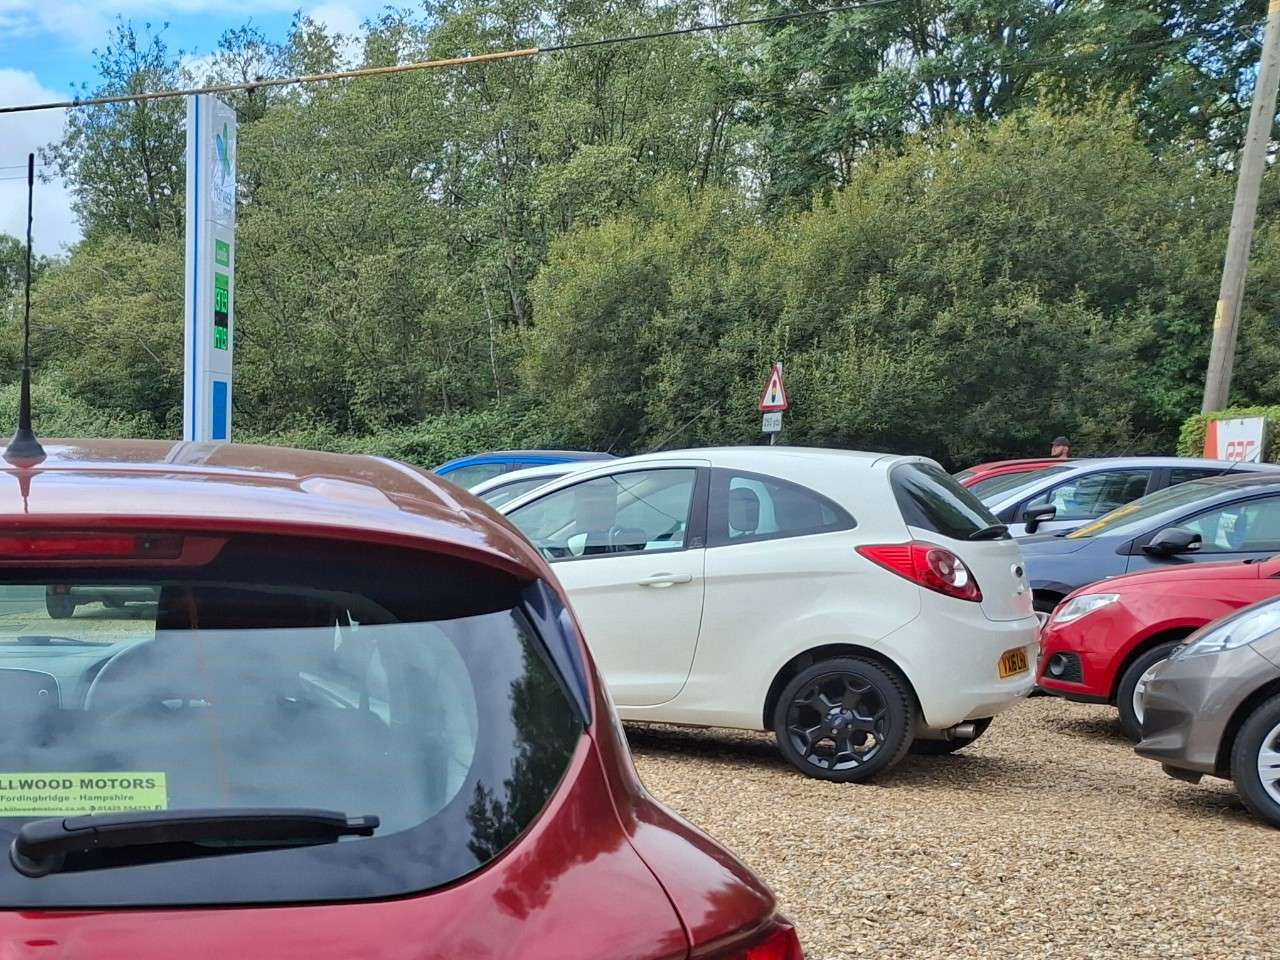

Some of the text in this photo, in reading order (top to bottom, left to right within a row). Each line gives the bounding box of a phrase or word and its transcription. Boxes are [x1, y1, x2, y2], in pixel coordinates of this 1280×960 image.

[80, 778, 157, 790] MOTORS
[0, 794, 70, 804] Fordingbridge
[80, 793, 135, 803] Hampshire
